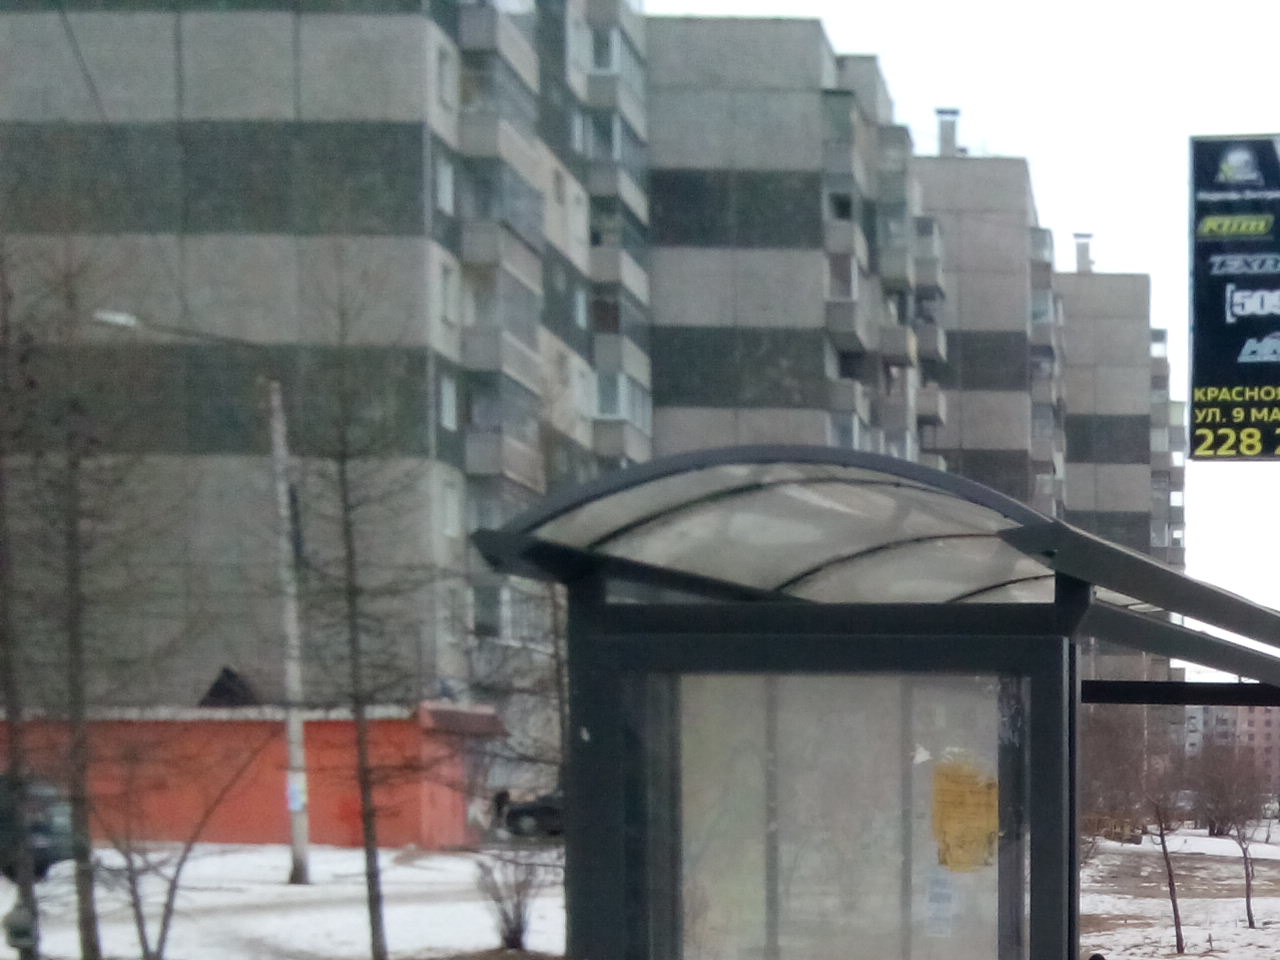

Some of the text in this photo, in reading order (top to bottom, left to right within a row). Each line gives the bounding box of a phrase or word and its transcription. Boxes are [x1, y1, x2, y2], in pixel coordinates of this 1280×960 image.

[1194, 407, 1227, 423] УЛ.
[1232, 407, 1245, 422] 9
[1194, 428, 1262, 456] 228
